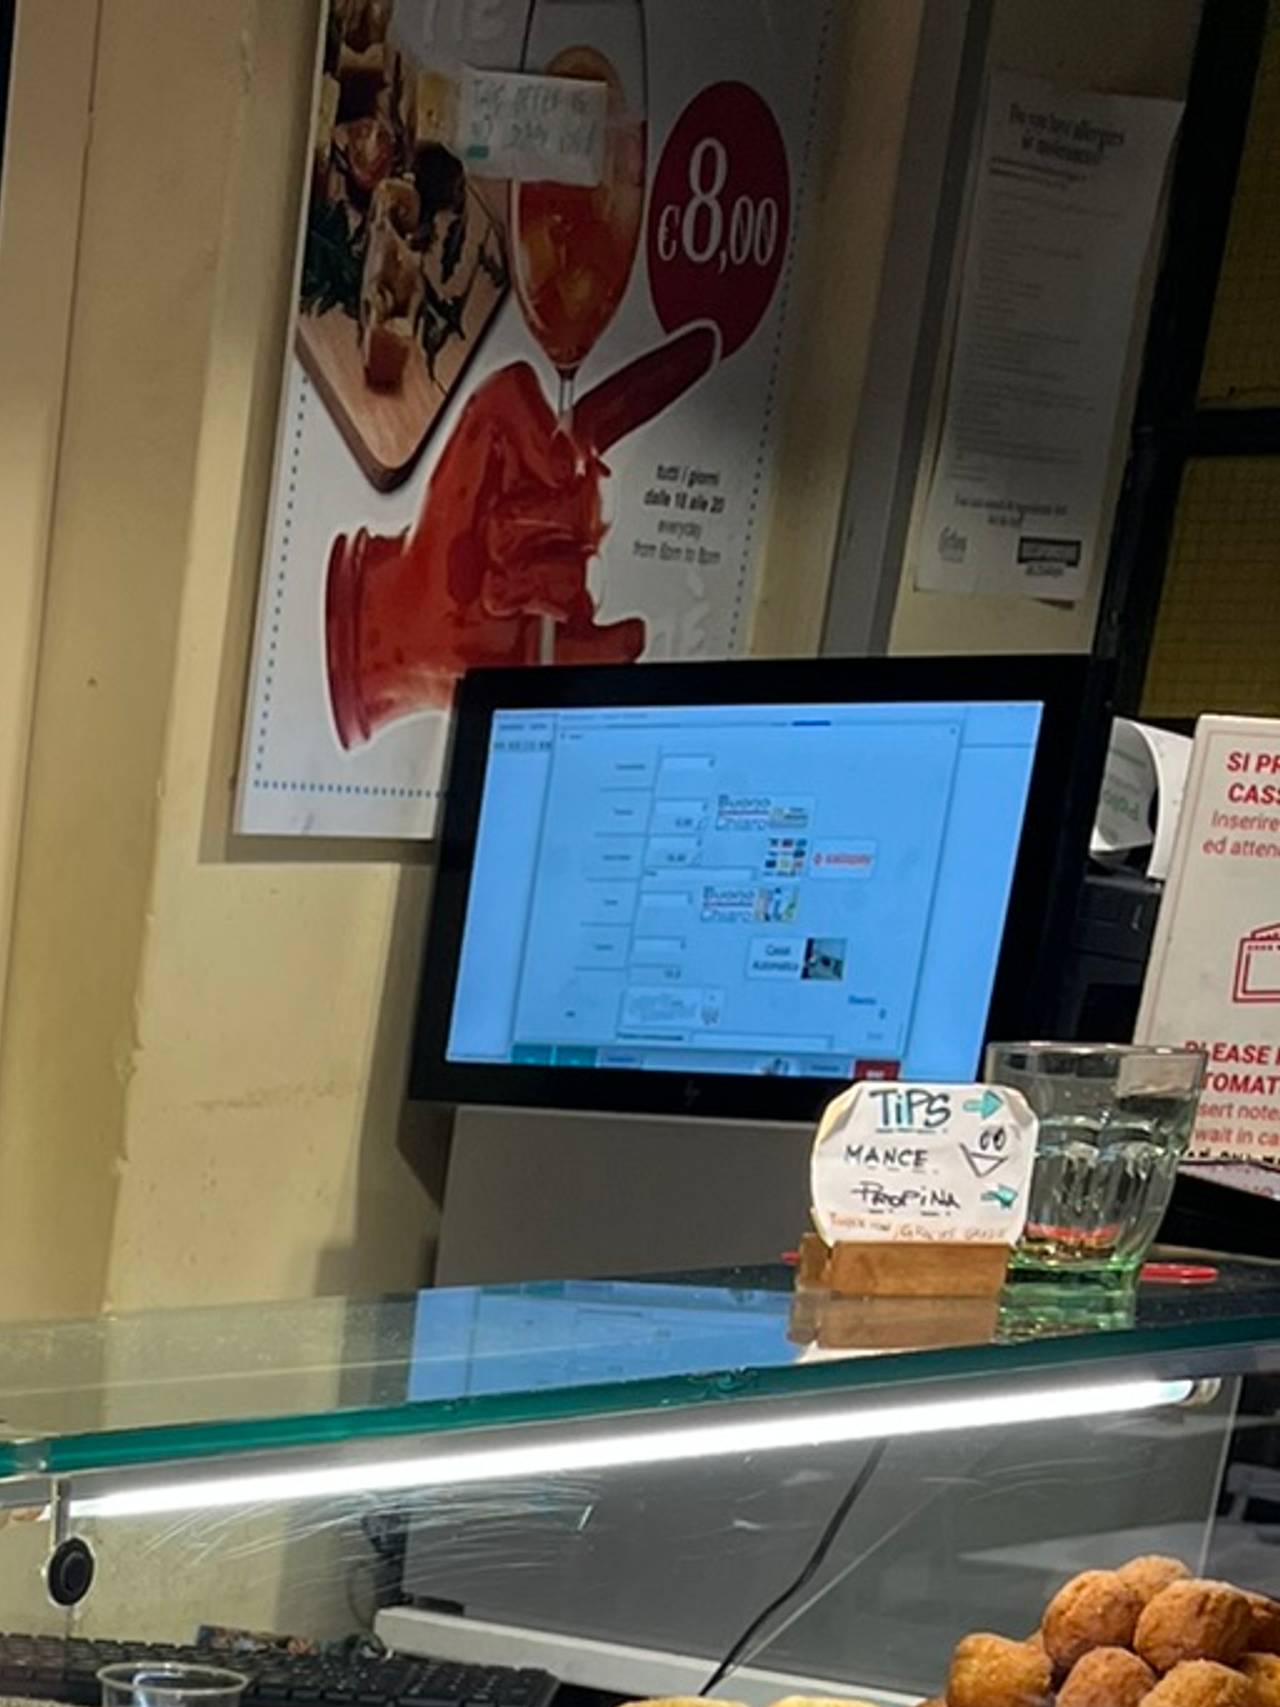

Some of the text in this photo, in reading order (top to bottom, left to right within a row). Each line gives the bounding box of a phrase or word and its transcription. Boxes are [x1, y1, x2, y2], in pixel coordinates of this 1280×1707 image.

[657, 136, 779, 275] €8,00
[1227, 752, 1250, 773] SI
[1203, 837, 1227, 855] ed
